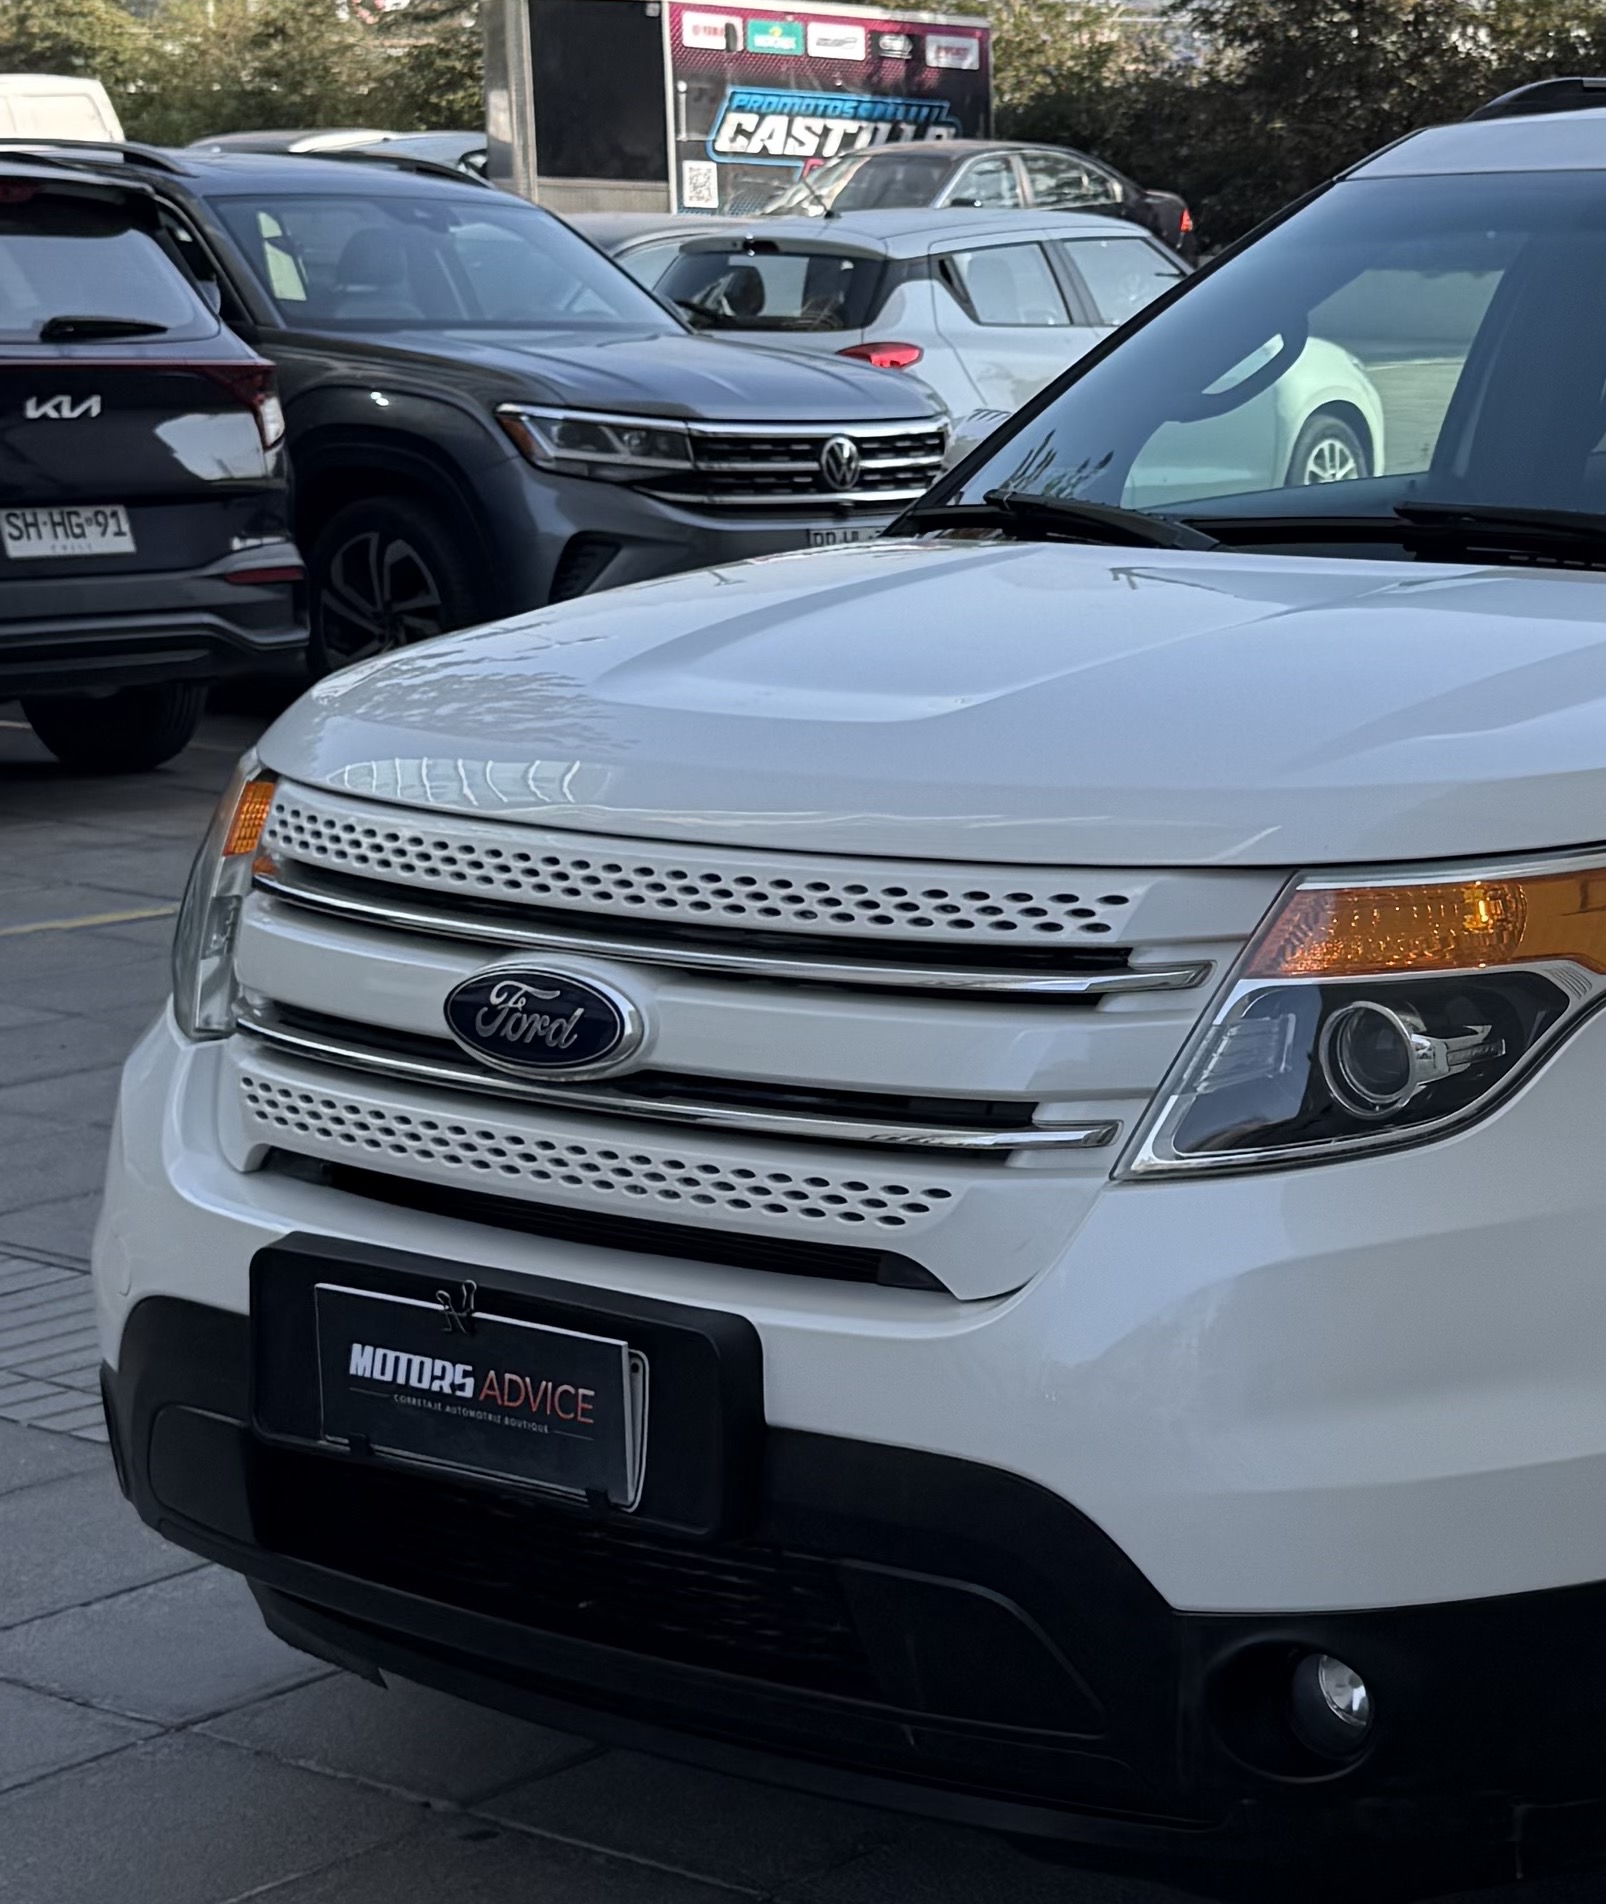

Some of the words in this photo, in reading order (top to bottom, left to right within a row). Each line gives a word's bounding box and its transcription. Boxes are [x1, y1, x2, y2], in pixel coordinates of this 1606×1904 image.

[25, 395, 101, 421] KIA
[475, 980, 585, 1049] Ford
[350, 1343, 475, 1398] MOTORS
[478, 1370, 596, 1424] ADVICE
